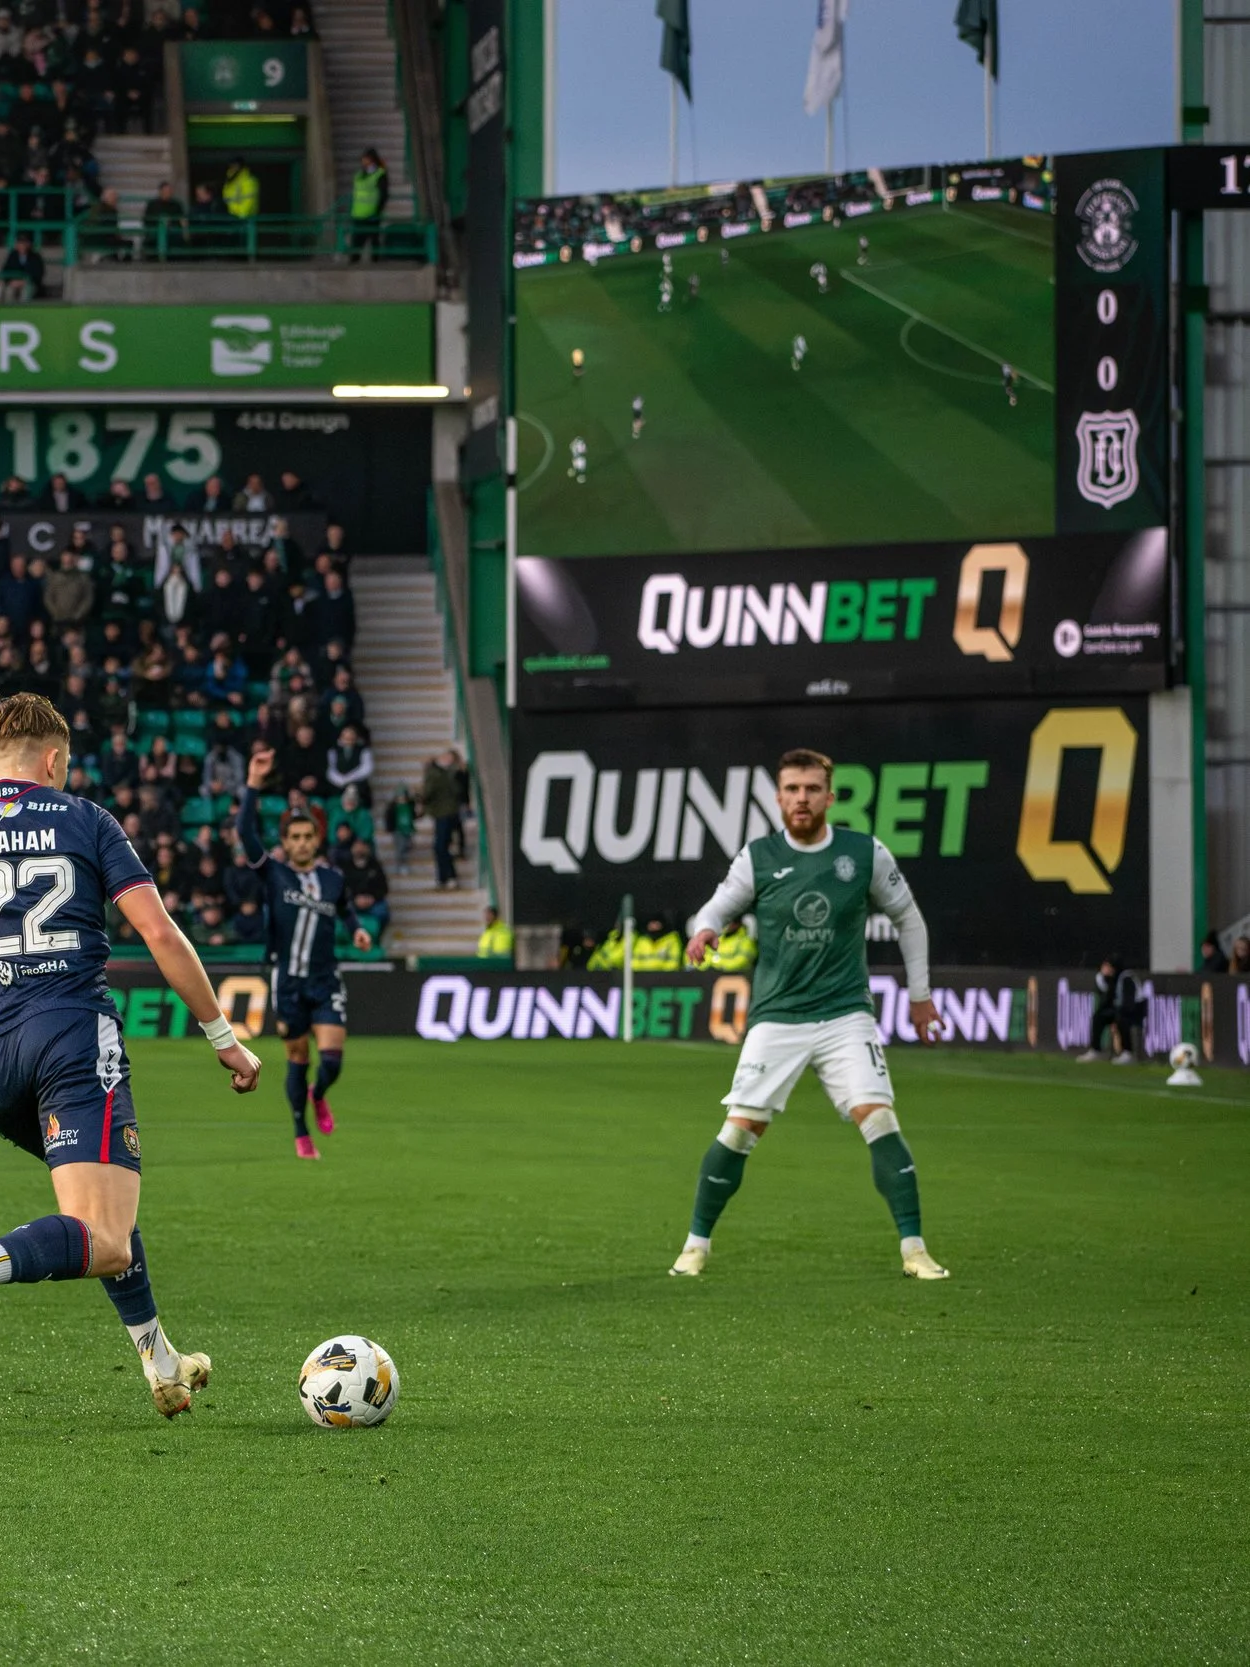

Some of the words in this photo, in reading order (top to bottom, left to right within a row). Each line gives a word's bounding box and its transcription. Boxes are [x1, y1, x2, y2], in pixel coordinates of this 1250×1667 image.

[262, 58, 285, 87] 9
[1096, 289, 1118, 325] 0
[1096, 355, 1118, 391] 0
[5, 410, 223, 484] 1875
[637, 572, 938, 654] QUINNBET
[952, 541, 1030, 663] Q
[26, 800, 68, 812] Blitz
[1015, 706, 1140, 895] Q
[415, 975, 703, 1043] QUINNBET
